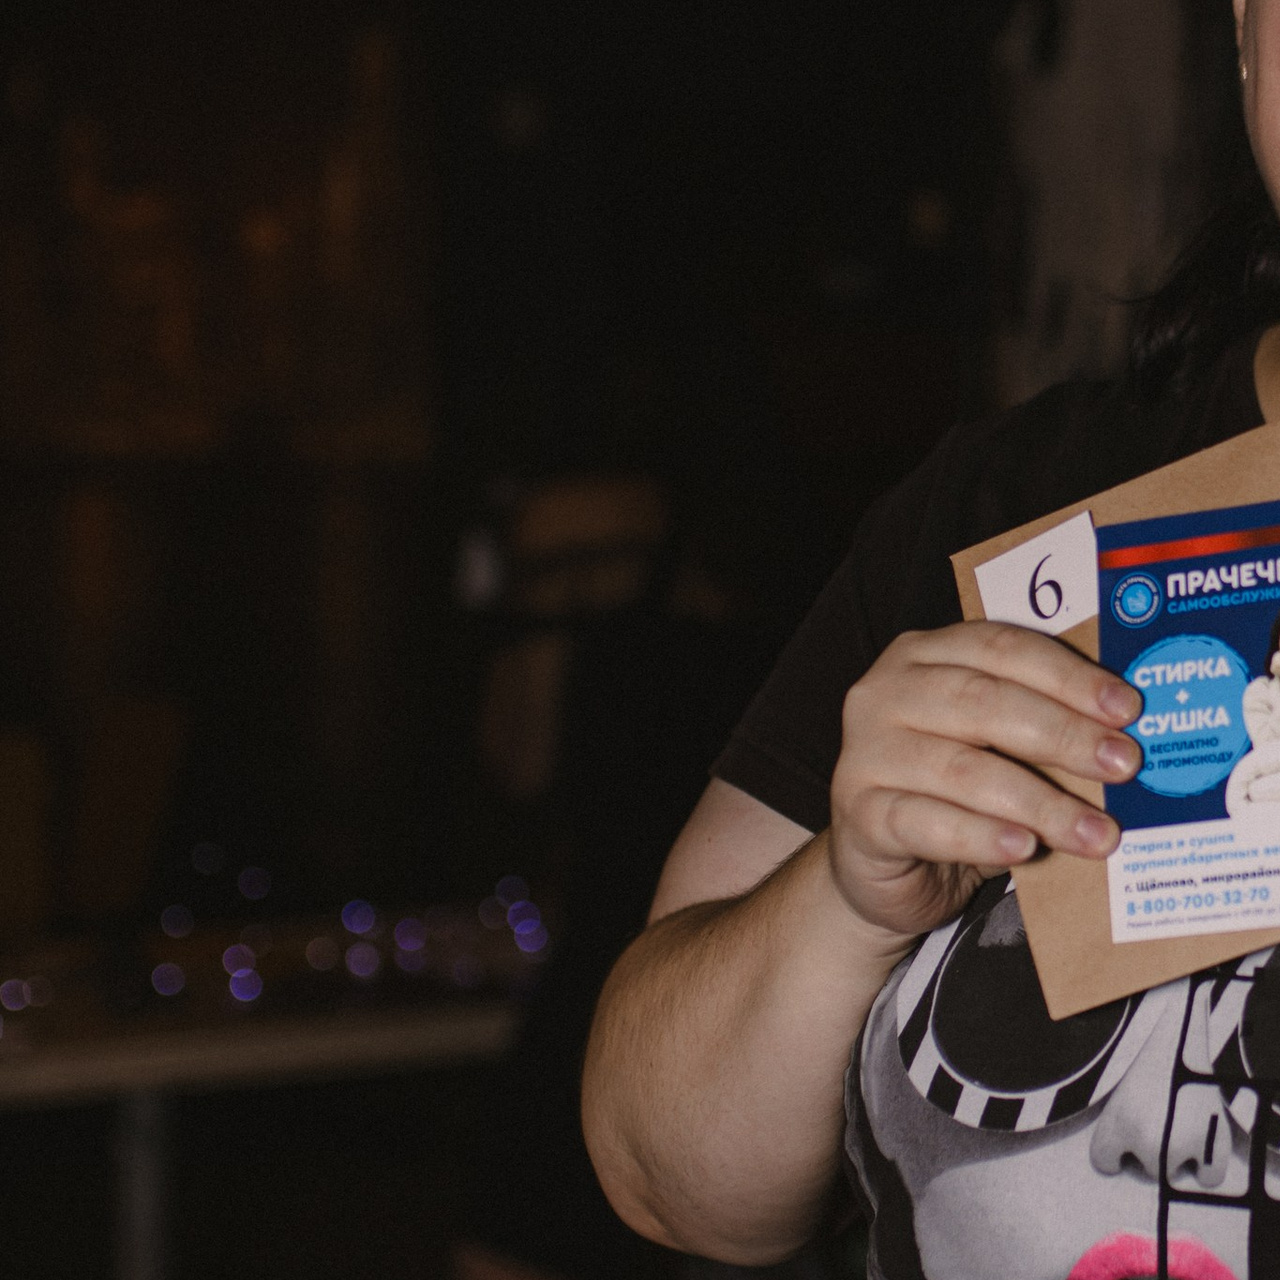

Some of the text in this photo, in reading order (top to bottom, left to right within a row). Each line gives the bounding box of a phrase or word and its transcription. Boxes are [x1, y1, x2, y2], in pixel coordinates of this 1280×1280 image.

[1029, 553, 1063, 619] 6
[1134, 657, 1232, 689] СТИРКА
[1137, 706, 1231, 737] СУШКА
[1149, 737, 1219, 755] БЕСПЛАТНО
[1157, 751, 1233, 770] ПРОМОКОДУ
